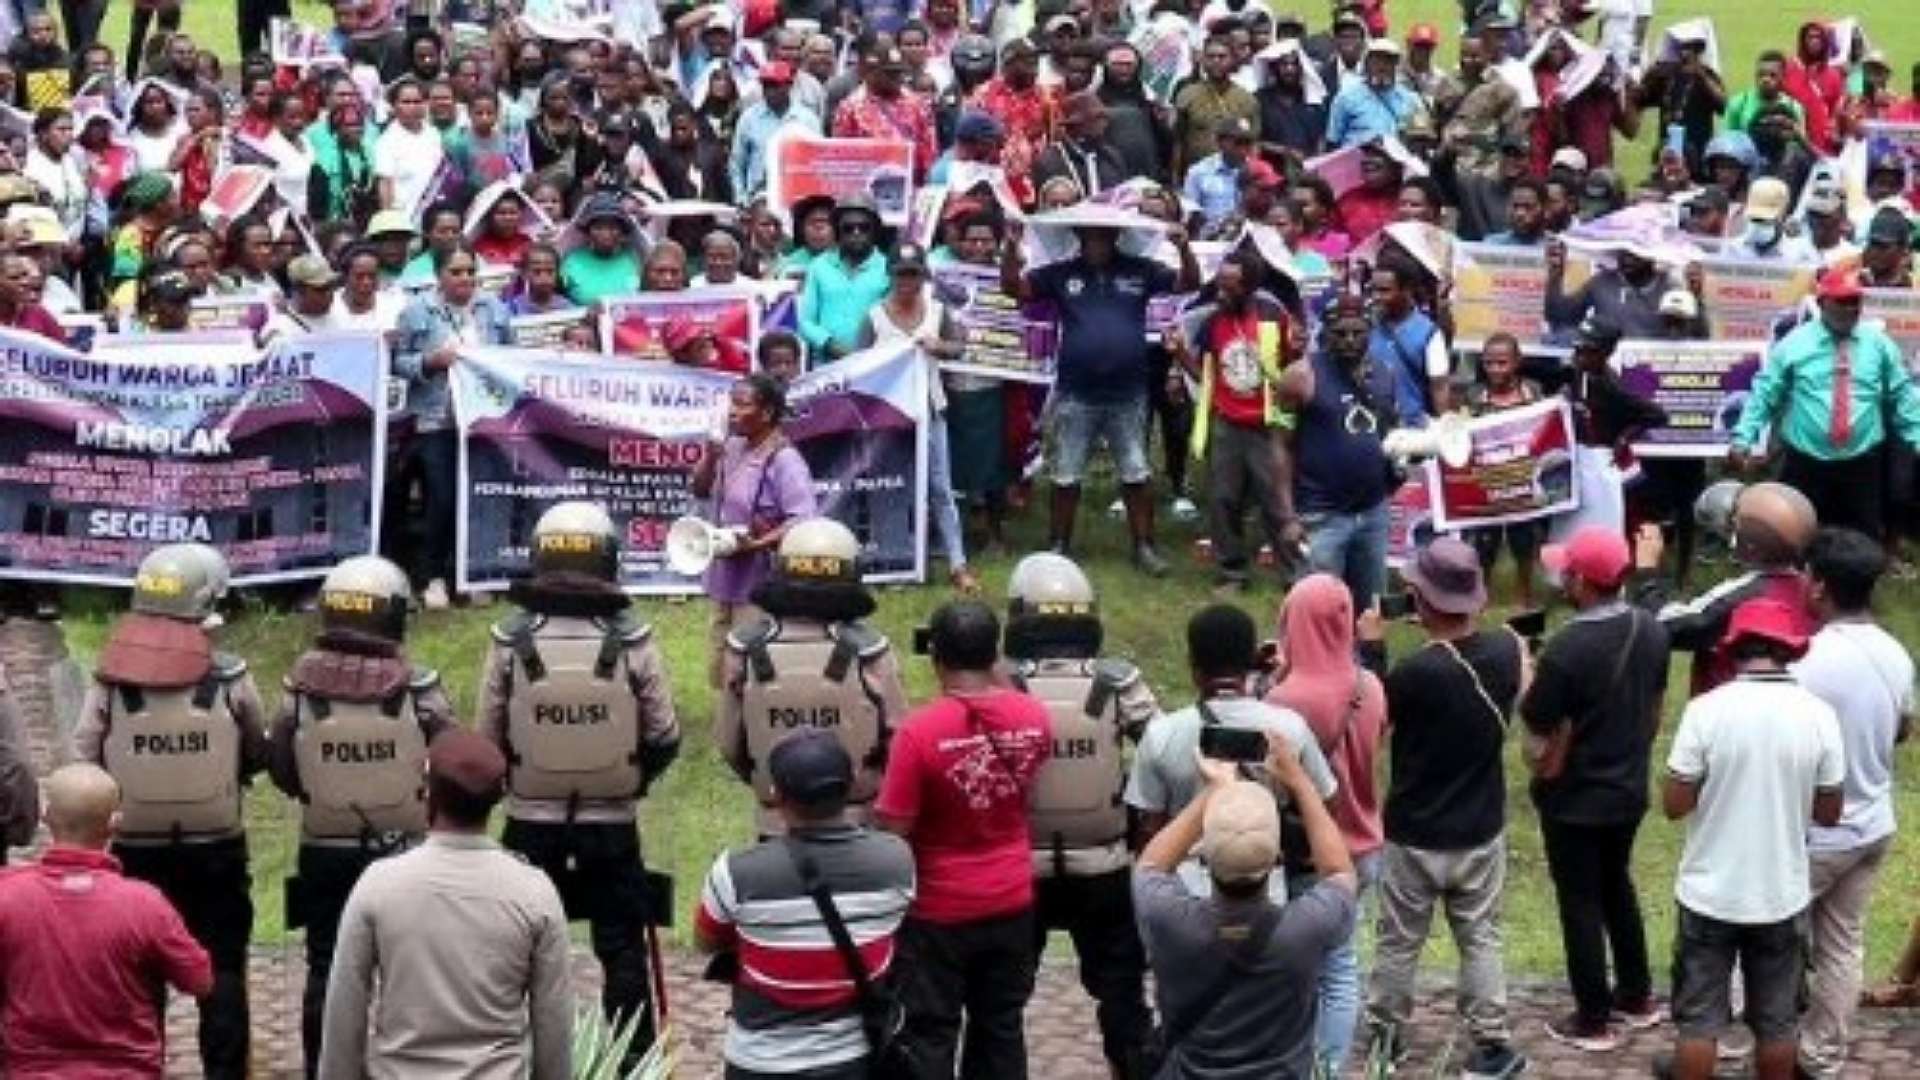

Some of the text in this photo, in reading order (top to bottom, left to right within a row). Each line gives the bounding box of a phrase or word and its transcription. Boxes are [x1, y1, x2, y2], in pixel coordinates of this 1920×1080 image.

[118, 362, 217, 388] WARGA
[75, 420, 231, 454] MENOLAK
[609, 438, 706, 467] MENO
[87, 510, 212, 541] SEGERA
[536, 702, 611, 725] POLISI
[768, 705, 840, 730] POLISI
[133, 730, 209, 756] POLISI
[321, 739, 396, 764] POLISI
[1053, 738, 1098, 758] LISI
